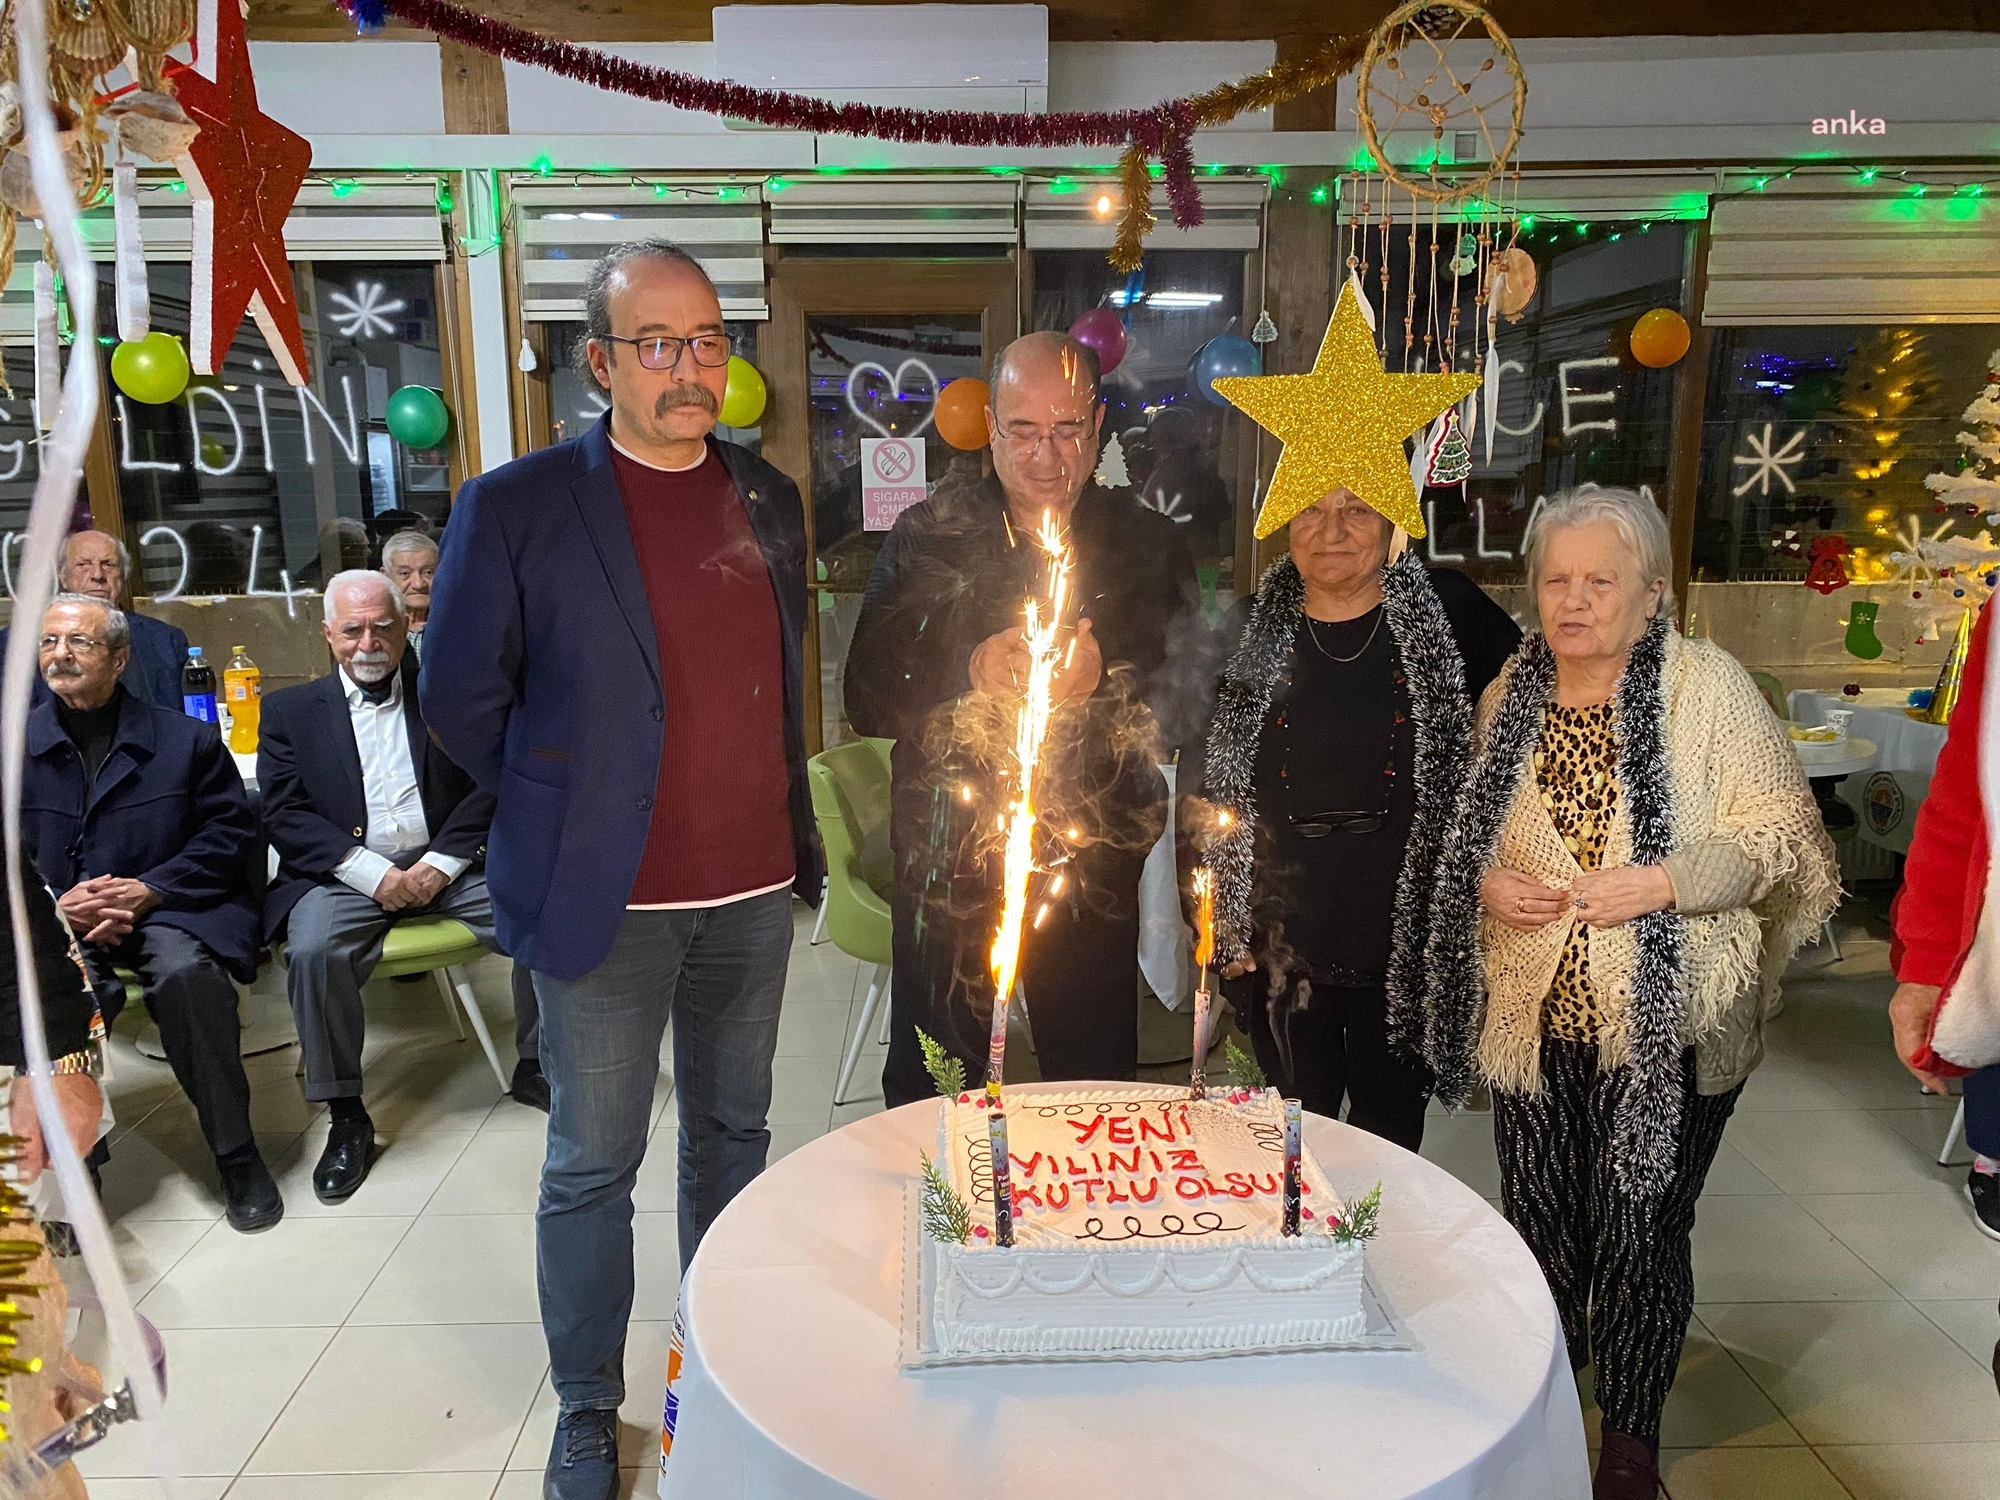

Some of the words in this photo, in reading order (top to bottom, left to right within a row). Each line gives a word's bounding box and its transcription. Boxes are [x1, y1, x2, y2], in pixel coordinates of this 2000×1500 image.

[873, 490, 917, 503] SİGARA
[877, 502, 909, 517] İÇME
[1066, 1103, 1192, 1144] YENİ
[1009, 1177, 1158, 1211] KUTLU
